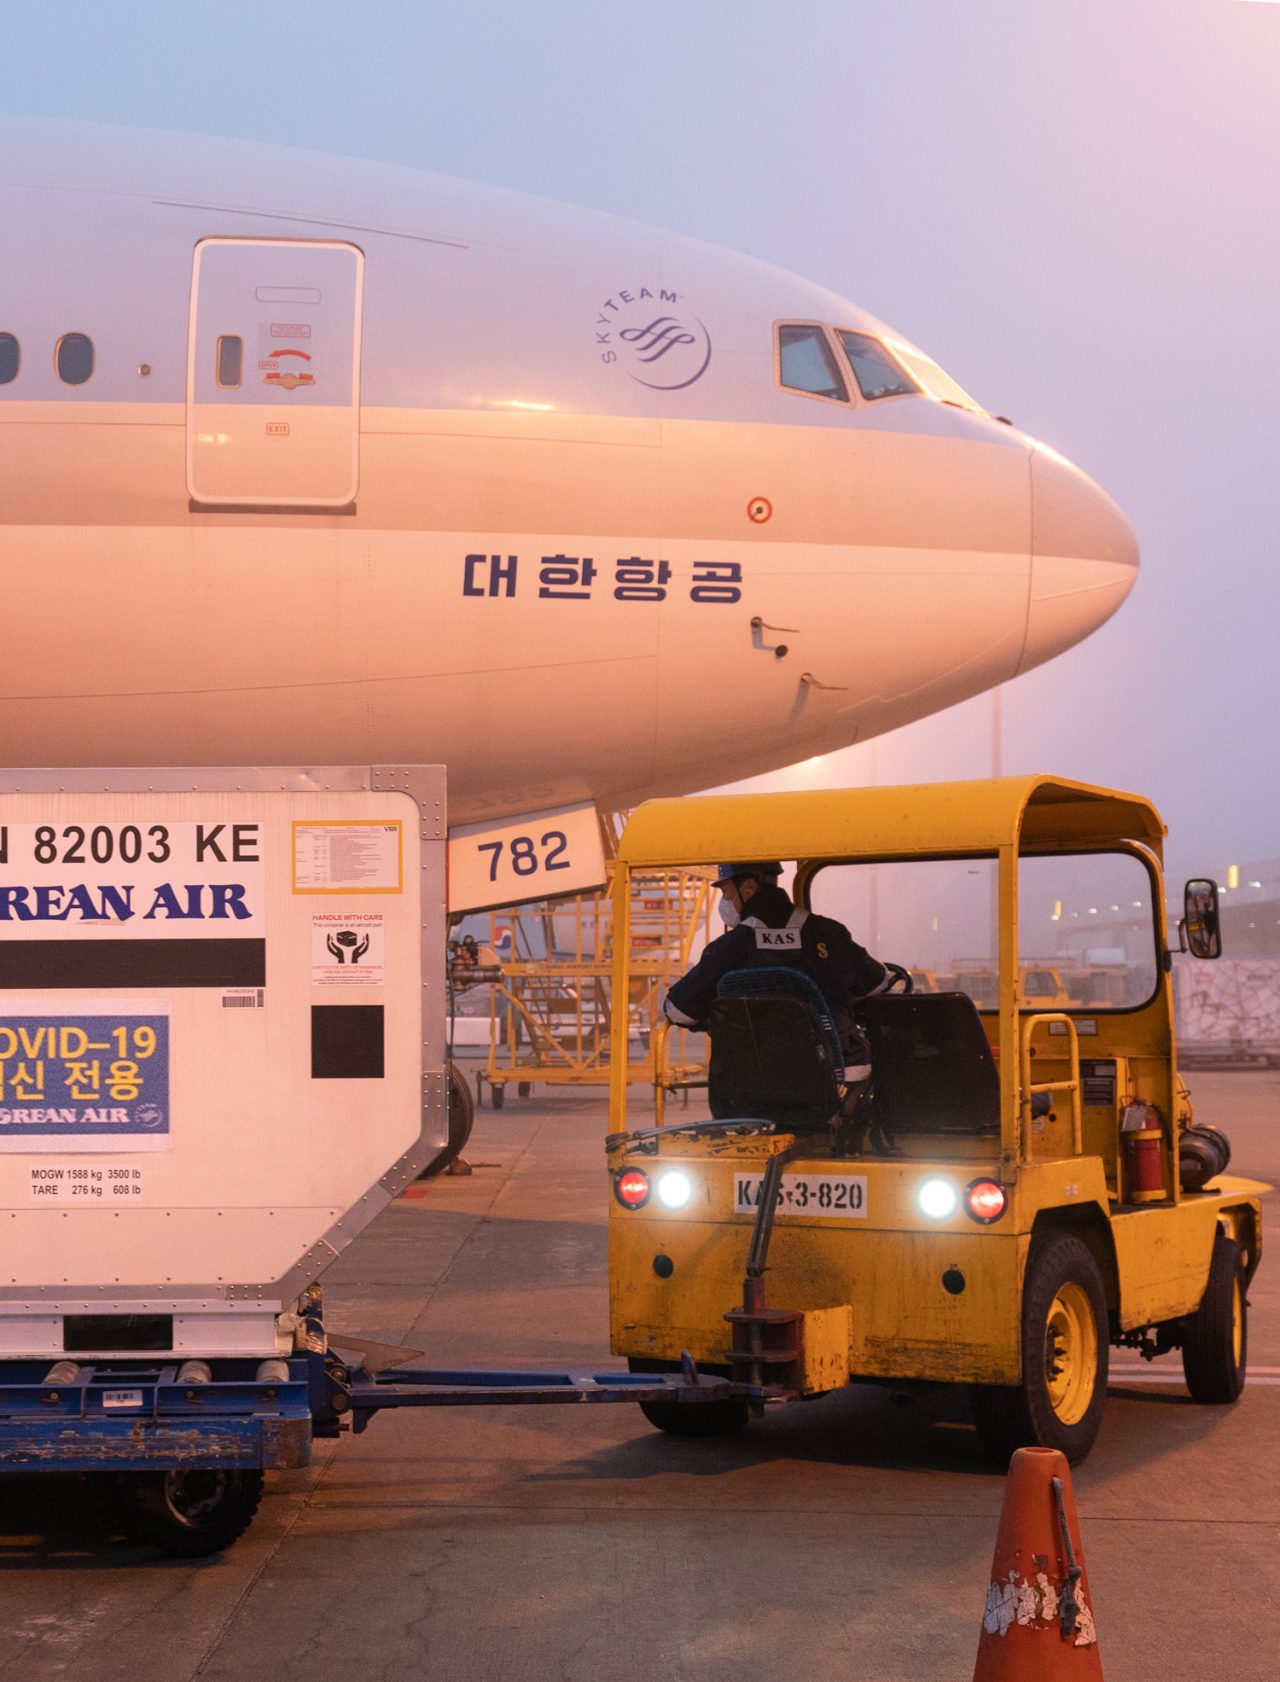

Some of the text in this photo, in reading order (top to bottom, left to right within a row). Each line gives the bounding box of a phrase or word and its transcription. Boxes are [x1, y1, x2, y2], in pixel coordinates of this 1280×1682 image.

[596, 287, 677, 364] SKYTEAM
[463, 554, 743, 604] 대한항공
[34, 825, 171, 864] 82003
[196, 824, 260, 862] KE
[478, 831, 570, 881] 782
[143, 883, 253, 920] AIR
[762, 933, 795, 944] KAS
[816, 942, 829, 958] S
[64, 1060, 144, 1101] 전용
[80, 1107, 131, 1123] AIR
[31, 1169, 141, 1181] MOGW 1588 kg 3500 lb
[32, 1185, 141, 1197] TARE 276 kg 608 lb
